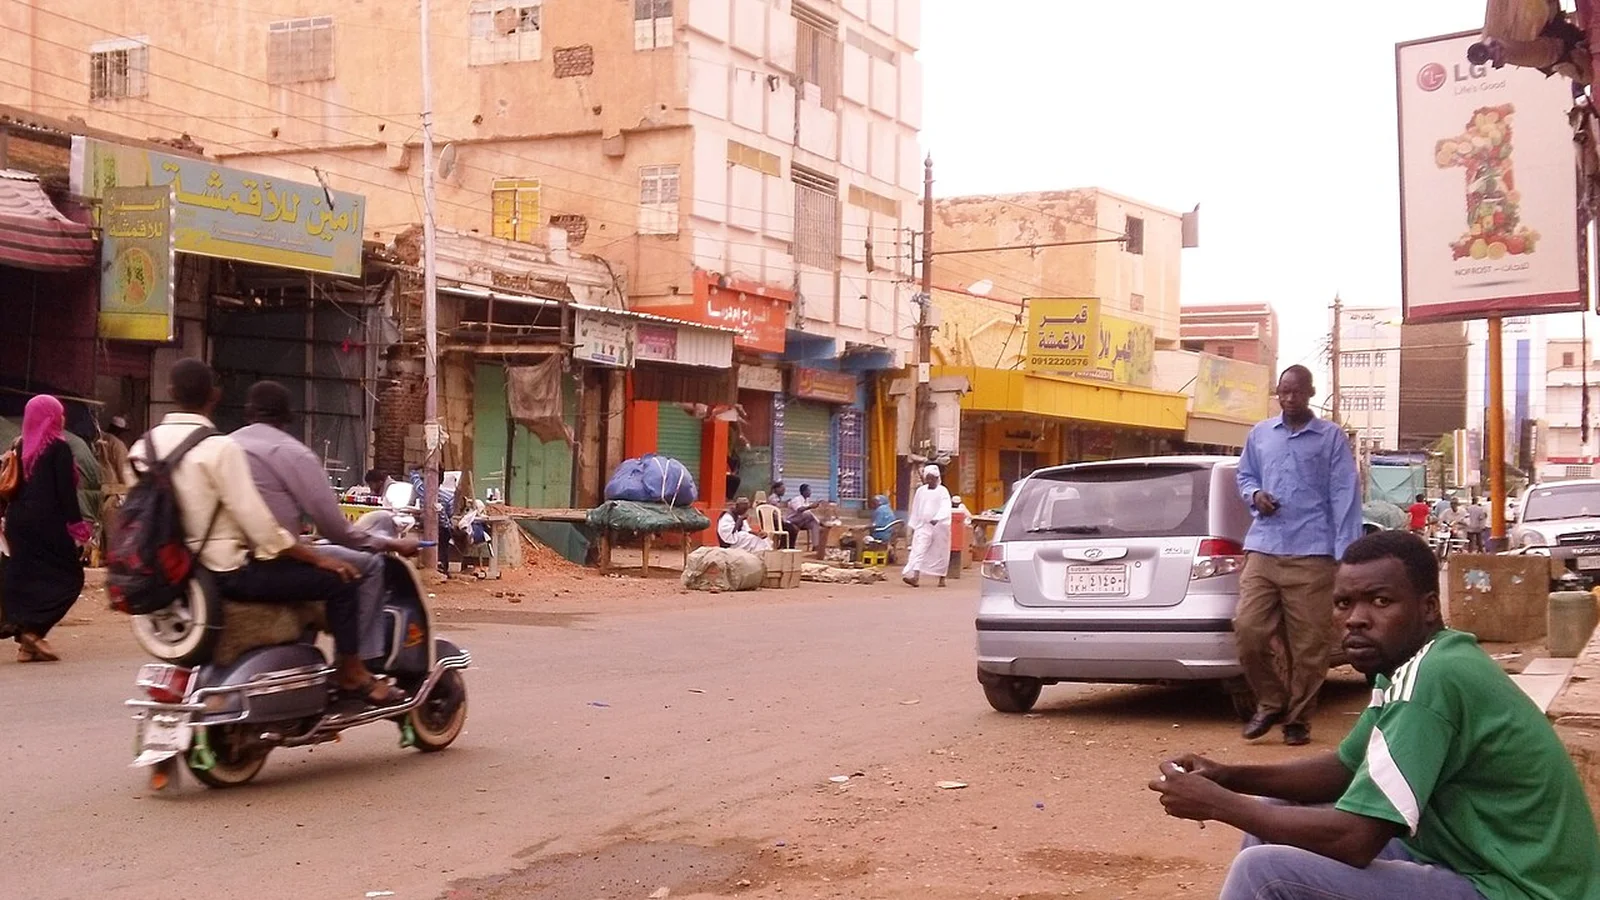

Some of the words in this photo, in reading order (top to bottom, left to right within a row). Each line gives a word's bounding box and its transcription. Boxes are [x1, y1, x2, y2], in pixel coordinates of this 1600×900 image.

[1453, 62, 1487, 82] LG
[1454, 84, 1477, 96] Life's
[1480, 80, 1507, 91] Good
[162, 161, 300, 223] للأقمشة
[306, 198, 359, 241] أمين
[1040, 305, 1088, 328] قمر
[1031, 357, 1089, 366] 0912220576
